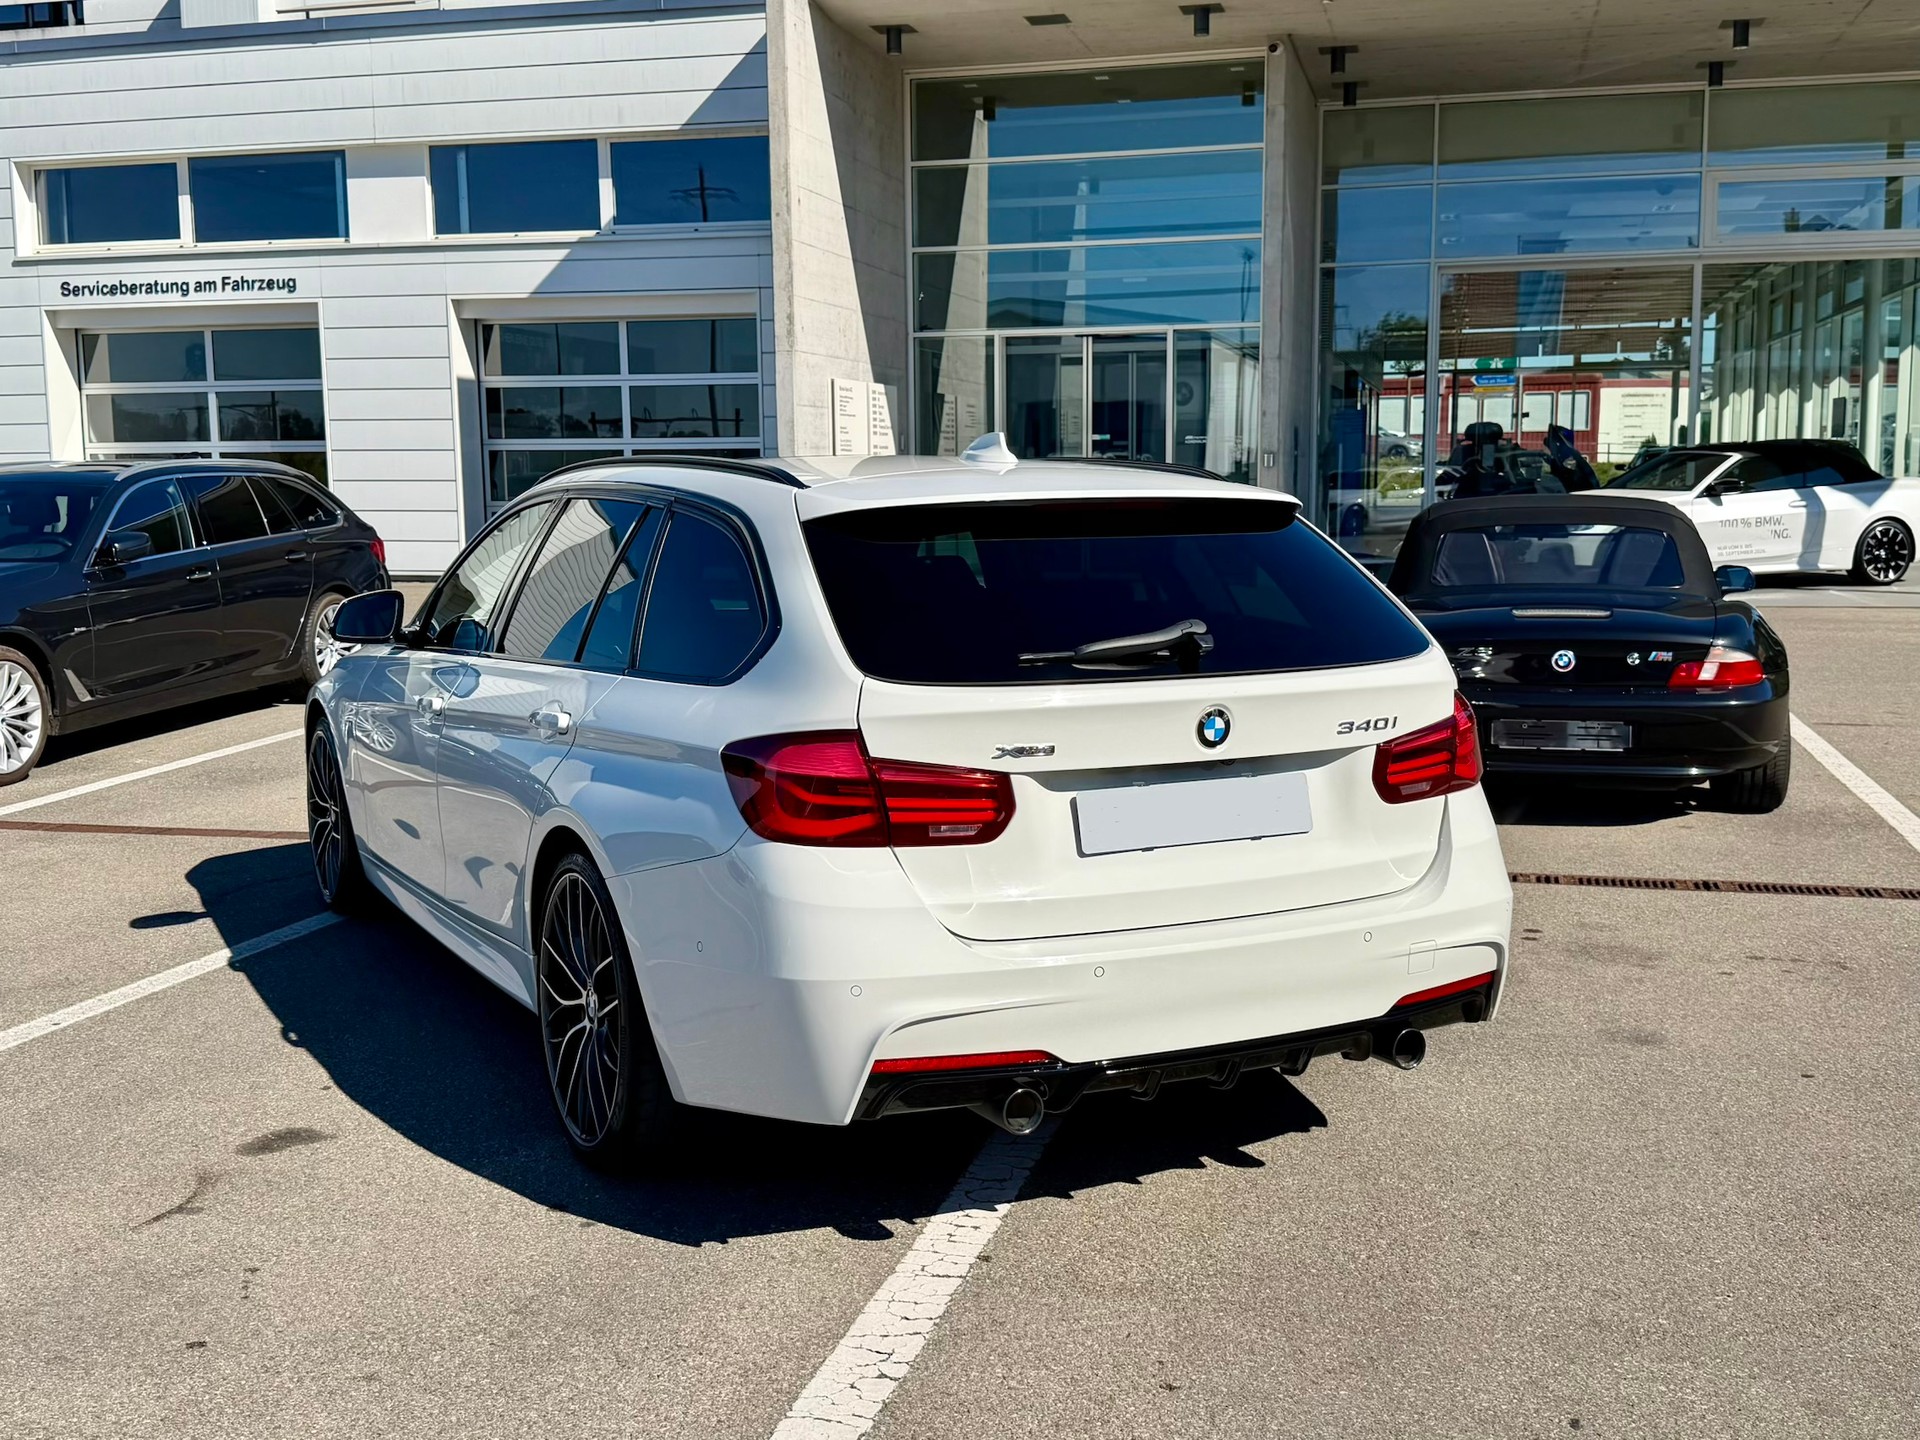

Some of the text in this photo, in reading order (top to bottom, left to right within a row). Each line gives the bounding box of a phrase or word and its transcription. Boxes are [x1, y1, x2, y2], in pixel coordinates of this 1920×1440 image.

[60, 275, 297, 297] Serviceberatung am Fahrzeug
[1754, 516, 1785, 528] BMW.
